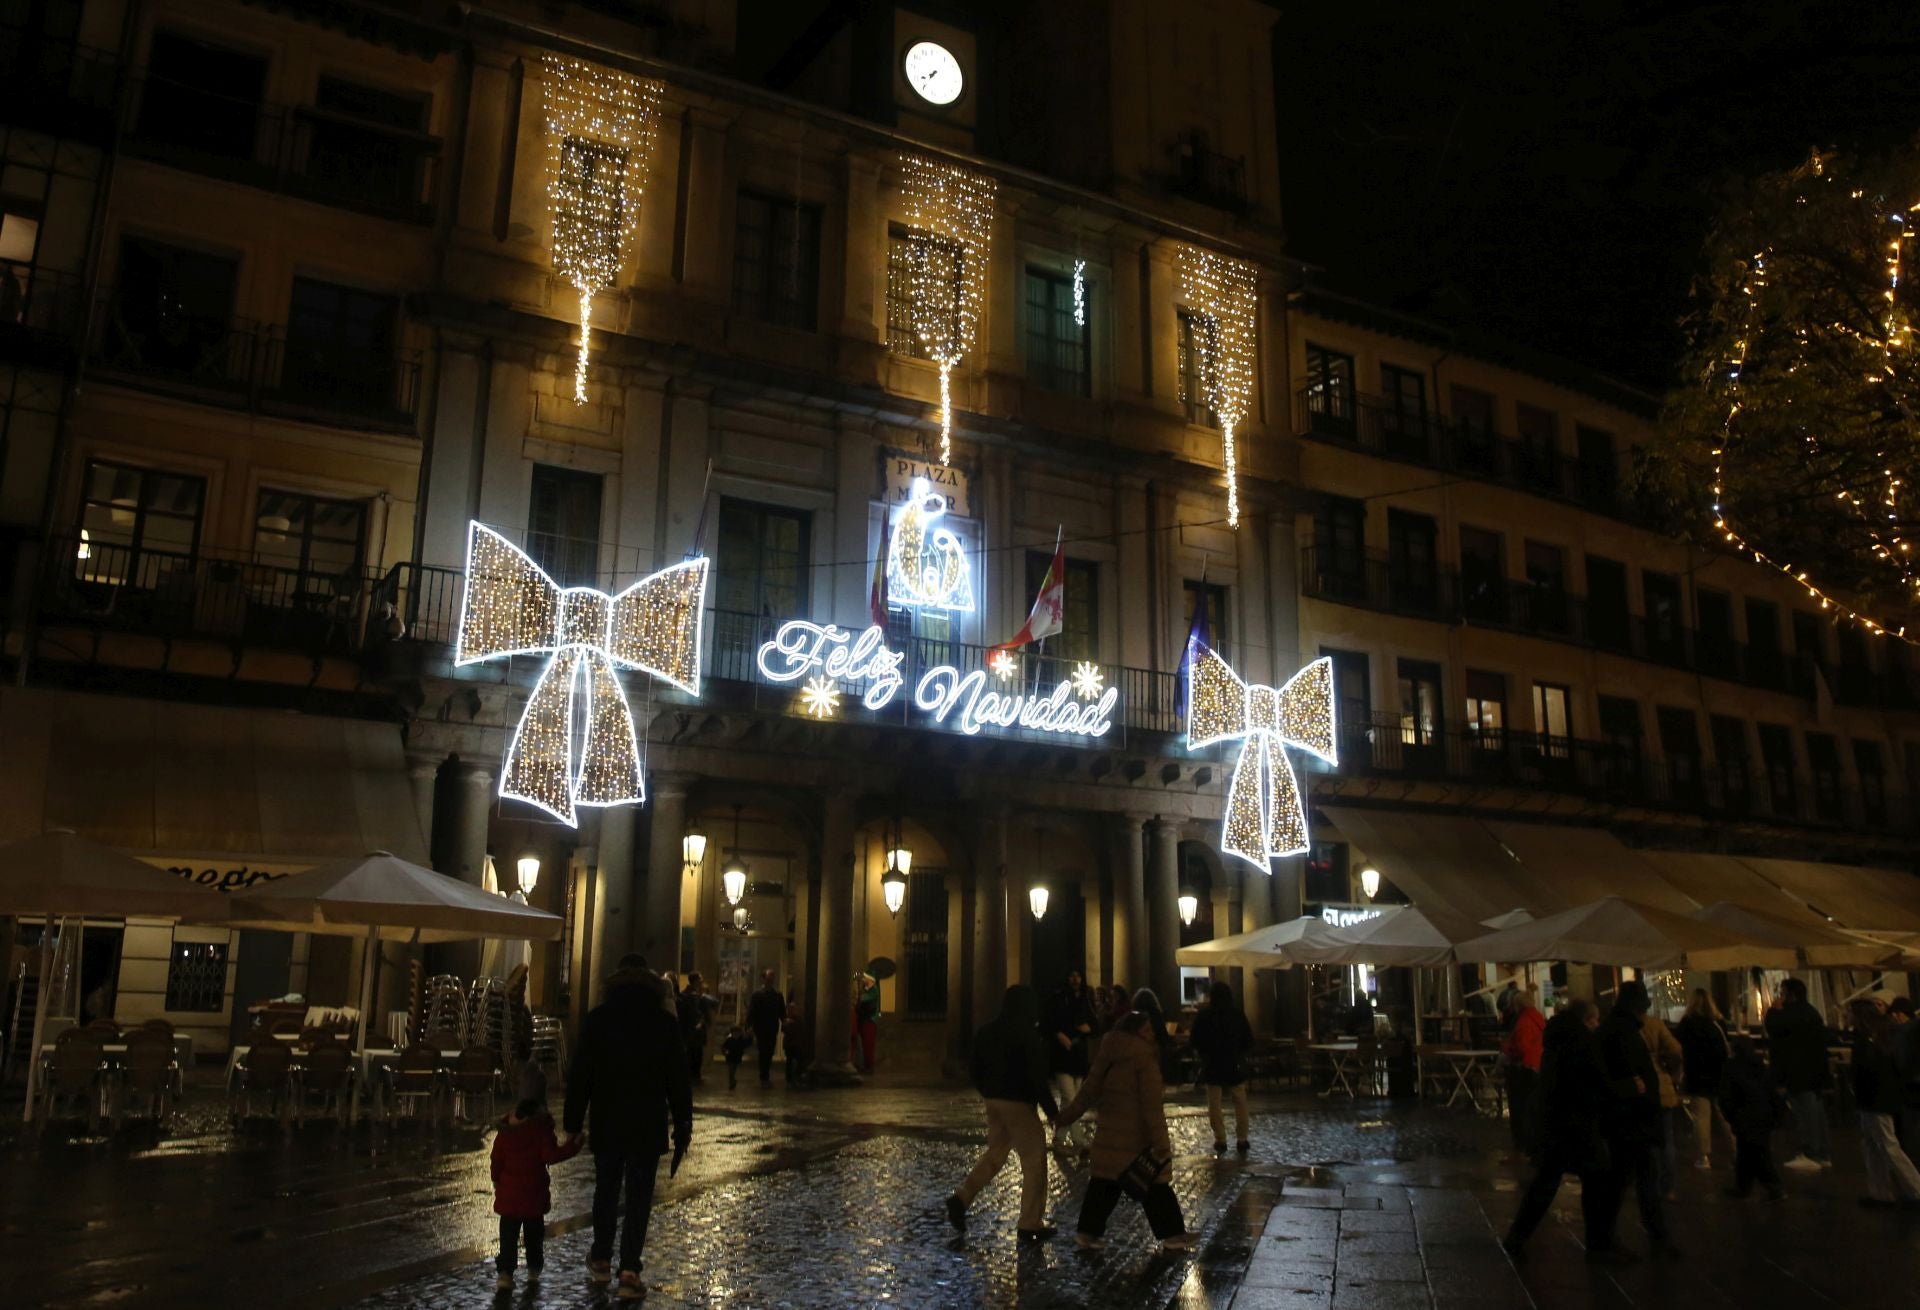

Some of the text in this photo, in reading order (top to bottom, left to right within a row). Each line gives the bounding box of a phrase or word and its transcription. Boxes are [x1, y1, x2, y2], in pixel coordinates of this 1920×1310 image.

[897, 460, 958, 486] PLAZA
[756, 620, 1119, 736] Feliz Navidad
